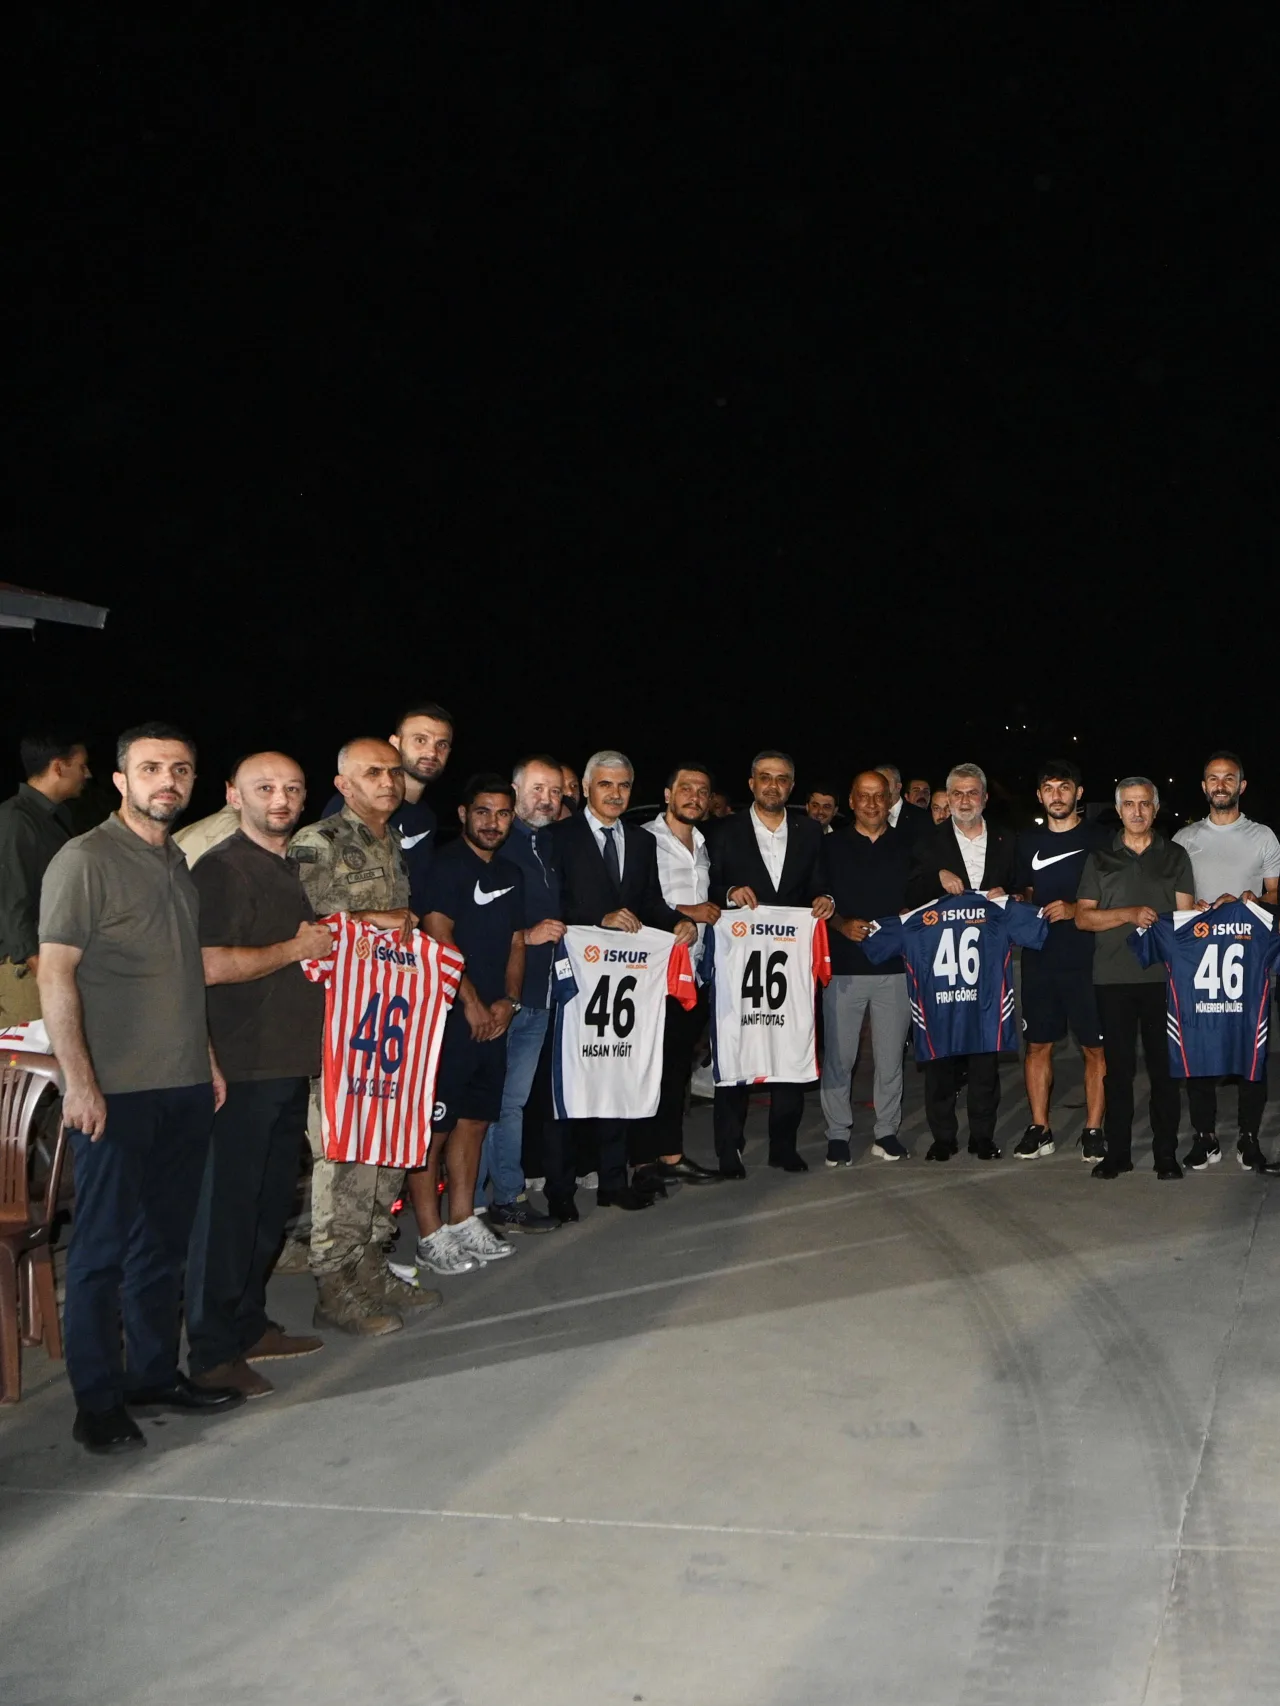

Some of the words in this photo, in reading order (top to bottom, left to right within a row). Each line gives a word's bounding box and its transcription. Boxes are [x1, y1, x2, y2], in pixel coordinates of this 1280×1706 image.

[741, 950, 789, 1010] 46
[933, 926, 981, 986] 46
[1194, 943, 1245, 1000] 46
[350, 992, 409, 1075] 46
[584, 974, 638, 1038] 46
[582, 1044, 610, 1058] HASAN
[612, 1041, 632, 1058] YİĞİT
